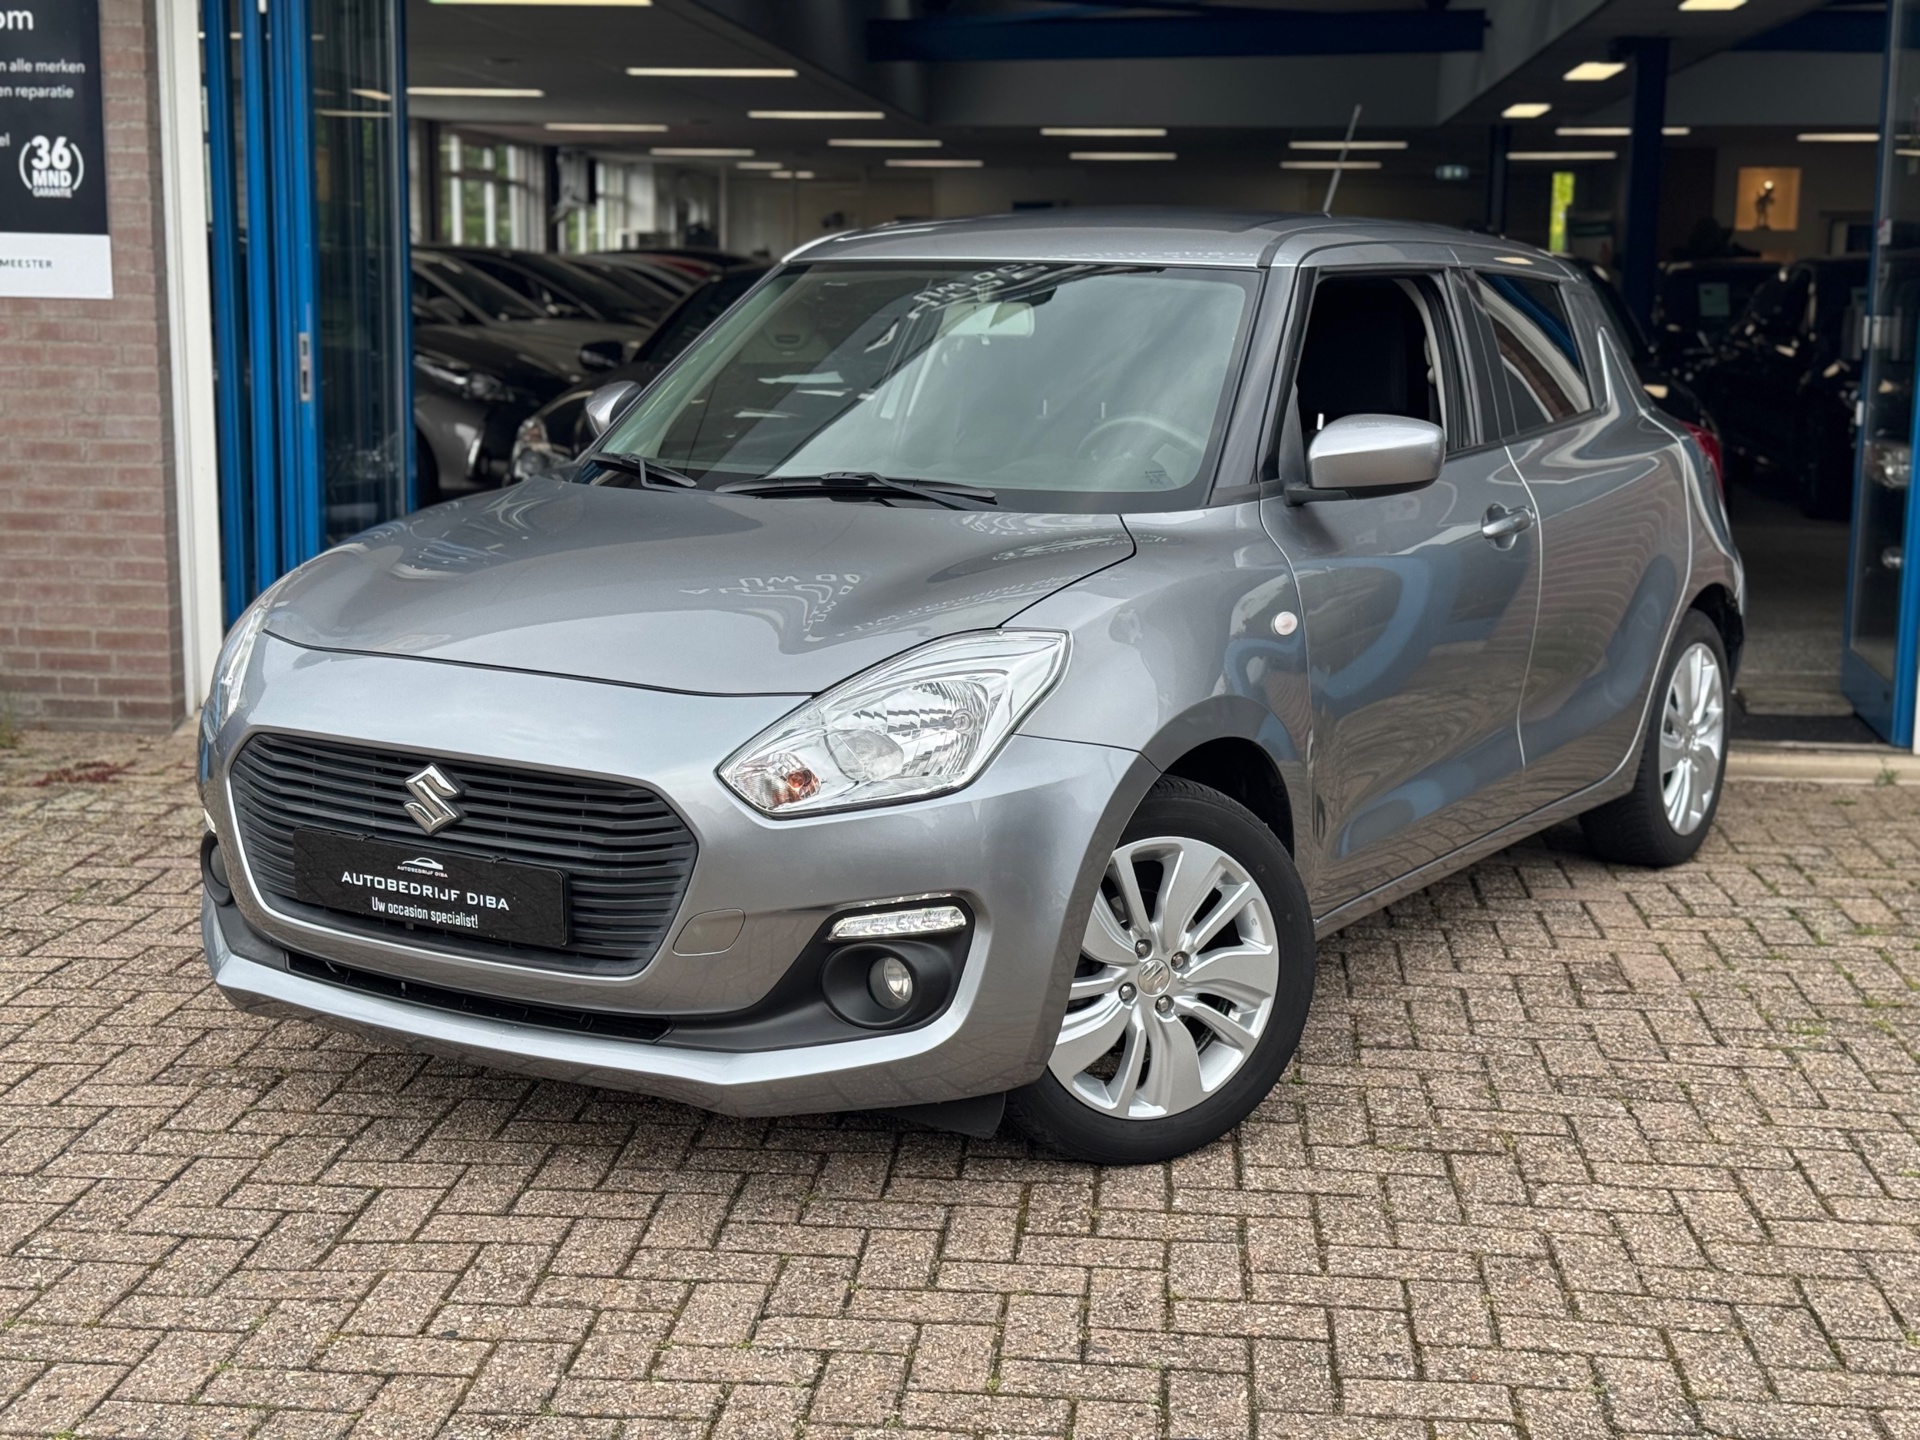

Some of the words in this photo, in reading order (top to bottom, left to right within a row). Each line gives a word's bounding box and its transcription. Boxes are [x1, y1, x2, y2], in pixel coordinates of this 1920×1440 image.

[9, 58, 33, 73] alle
[35, 59, 86, 74] merken
[15, 85, 74, 101] reparatie
[31, 135, 72, 170] 36
[32, 169, 72, 188] MND
[32, 186, 73, 198] GARANTIE
[341, 871, 461, 902] AUTOBEDRIJF
[466, 892, 510, 911] DIBA
[371, 896, 386, 913] Uw
[387, 903, 429, 920] occasion
[430, 910, 479, 929] specialist!
